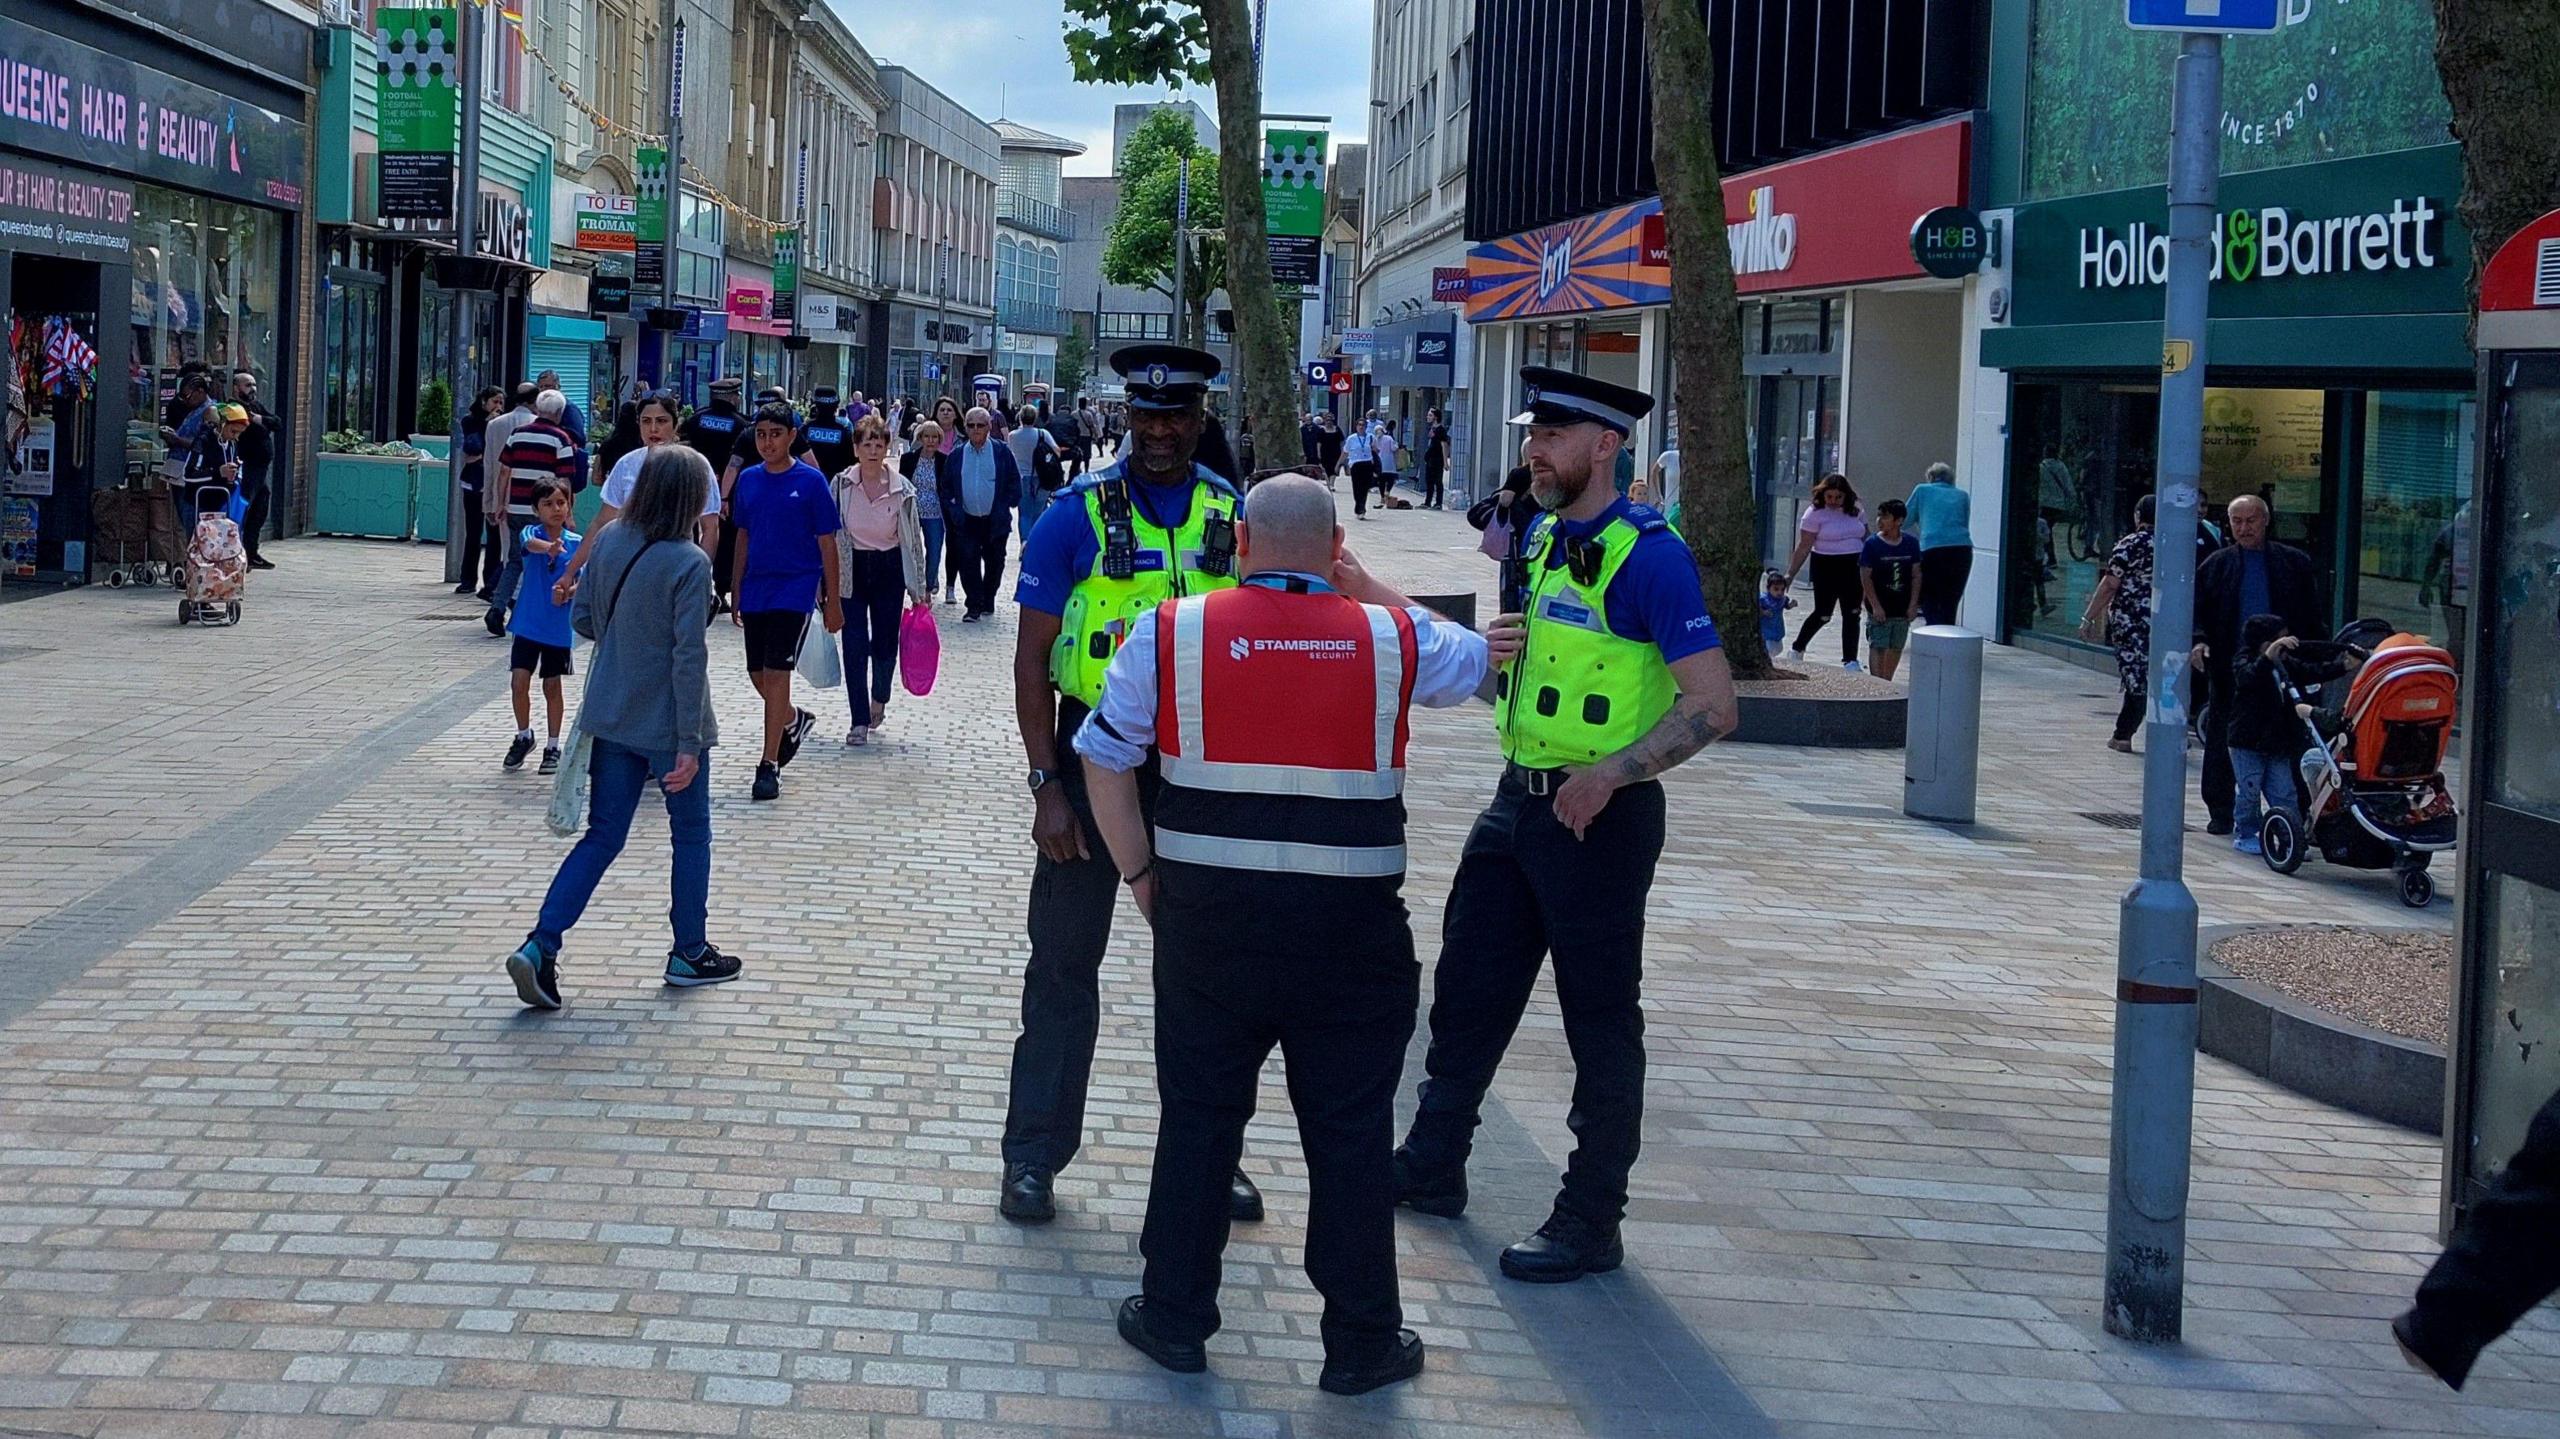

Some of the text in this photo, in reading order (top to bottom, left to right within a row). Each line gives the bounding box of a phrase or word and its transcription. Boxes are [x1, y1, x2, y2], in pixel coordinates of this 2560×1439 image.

[383, 91, 423, 100] FOOTBALL
[0, 58, 218, 168] UEENS HAIR & BEAUTY
[2220, 82, 2319, 144] INCE 1870
[0, 168, 13, 205] UR
[17, 171, 28, 207] #1
[31, 174, 55, 212] HAIR
[68, 182, 106, 220] BEAUTY
[108, 189, 131, 224] STOP
[586, 196, 636, 212] TO LET
[580, 217, 636, 232] TROMAN
[1727, 185, 1797, 274] wilko
[1926, 227, 1976, 248] H&B
[2080, 213, 2223, 289] Hollad
[2261, 196, 2434, 276] Barrett
[808, 305, 829, 315] M&S
[701, 418, 732, 432] POLICE
[2214, 422, 2261, 434] wellness
[808, 429, 840, 441] POLICE
[2225, 434, 2258, 446] heart
[1254, 640, 1357, 651] STAMBRIDGE
[1309, 652, 1357, 660] SECURITY
